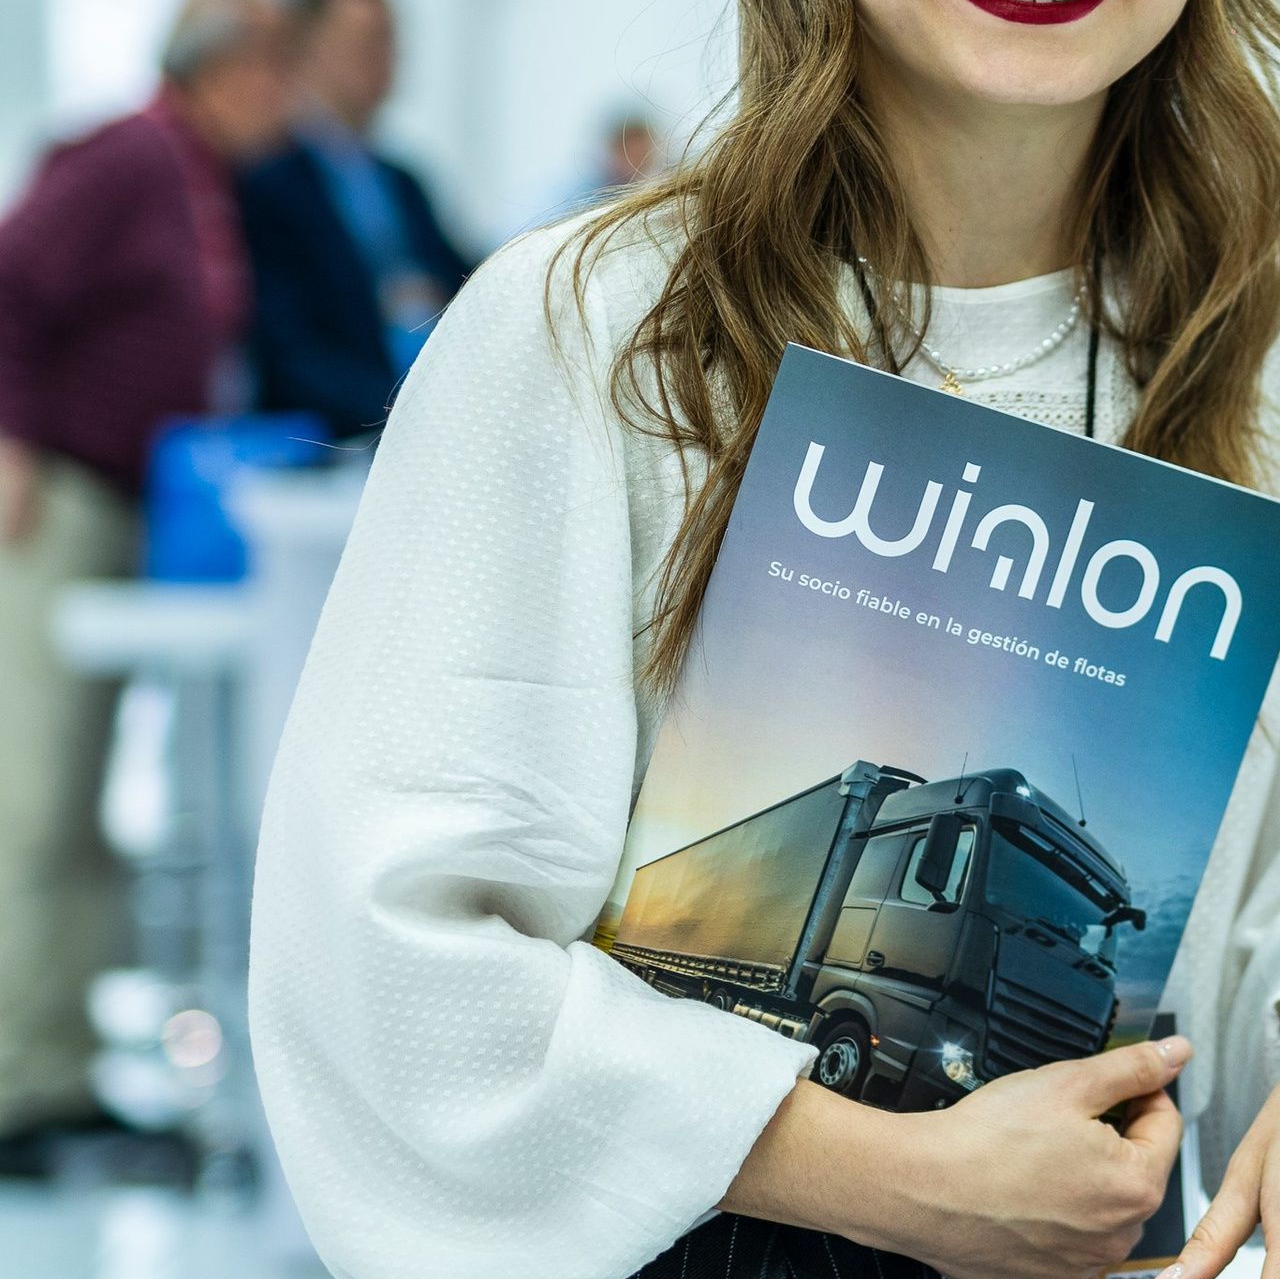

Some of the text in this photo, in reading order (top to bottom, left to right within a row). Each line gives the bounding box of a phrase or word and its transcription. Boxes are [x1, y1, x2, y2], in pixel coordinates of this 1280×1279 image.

[768, 561, 1127, 687] Su socio fiable en la gestión de flotas
